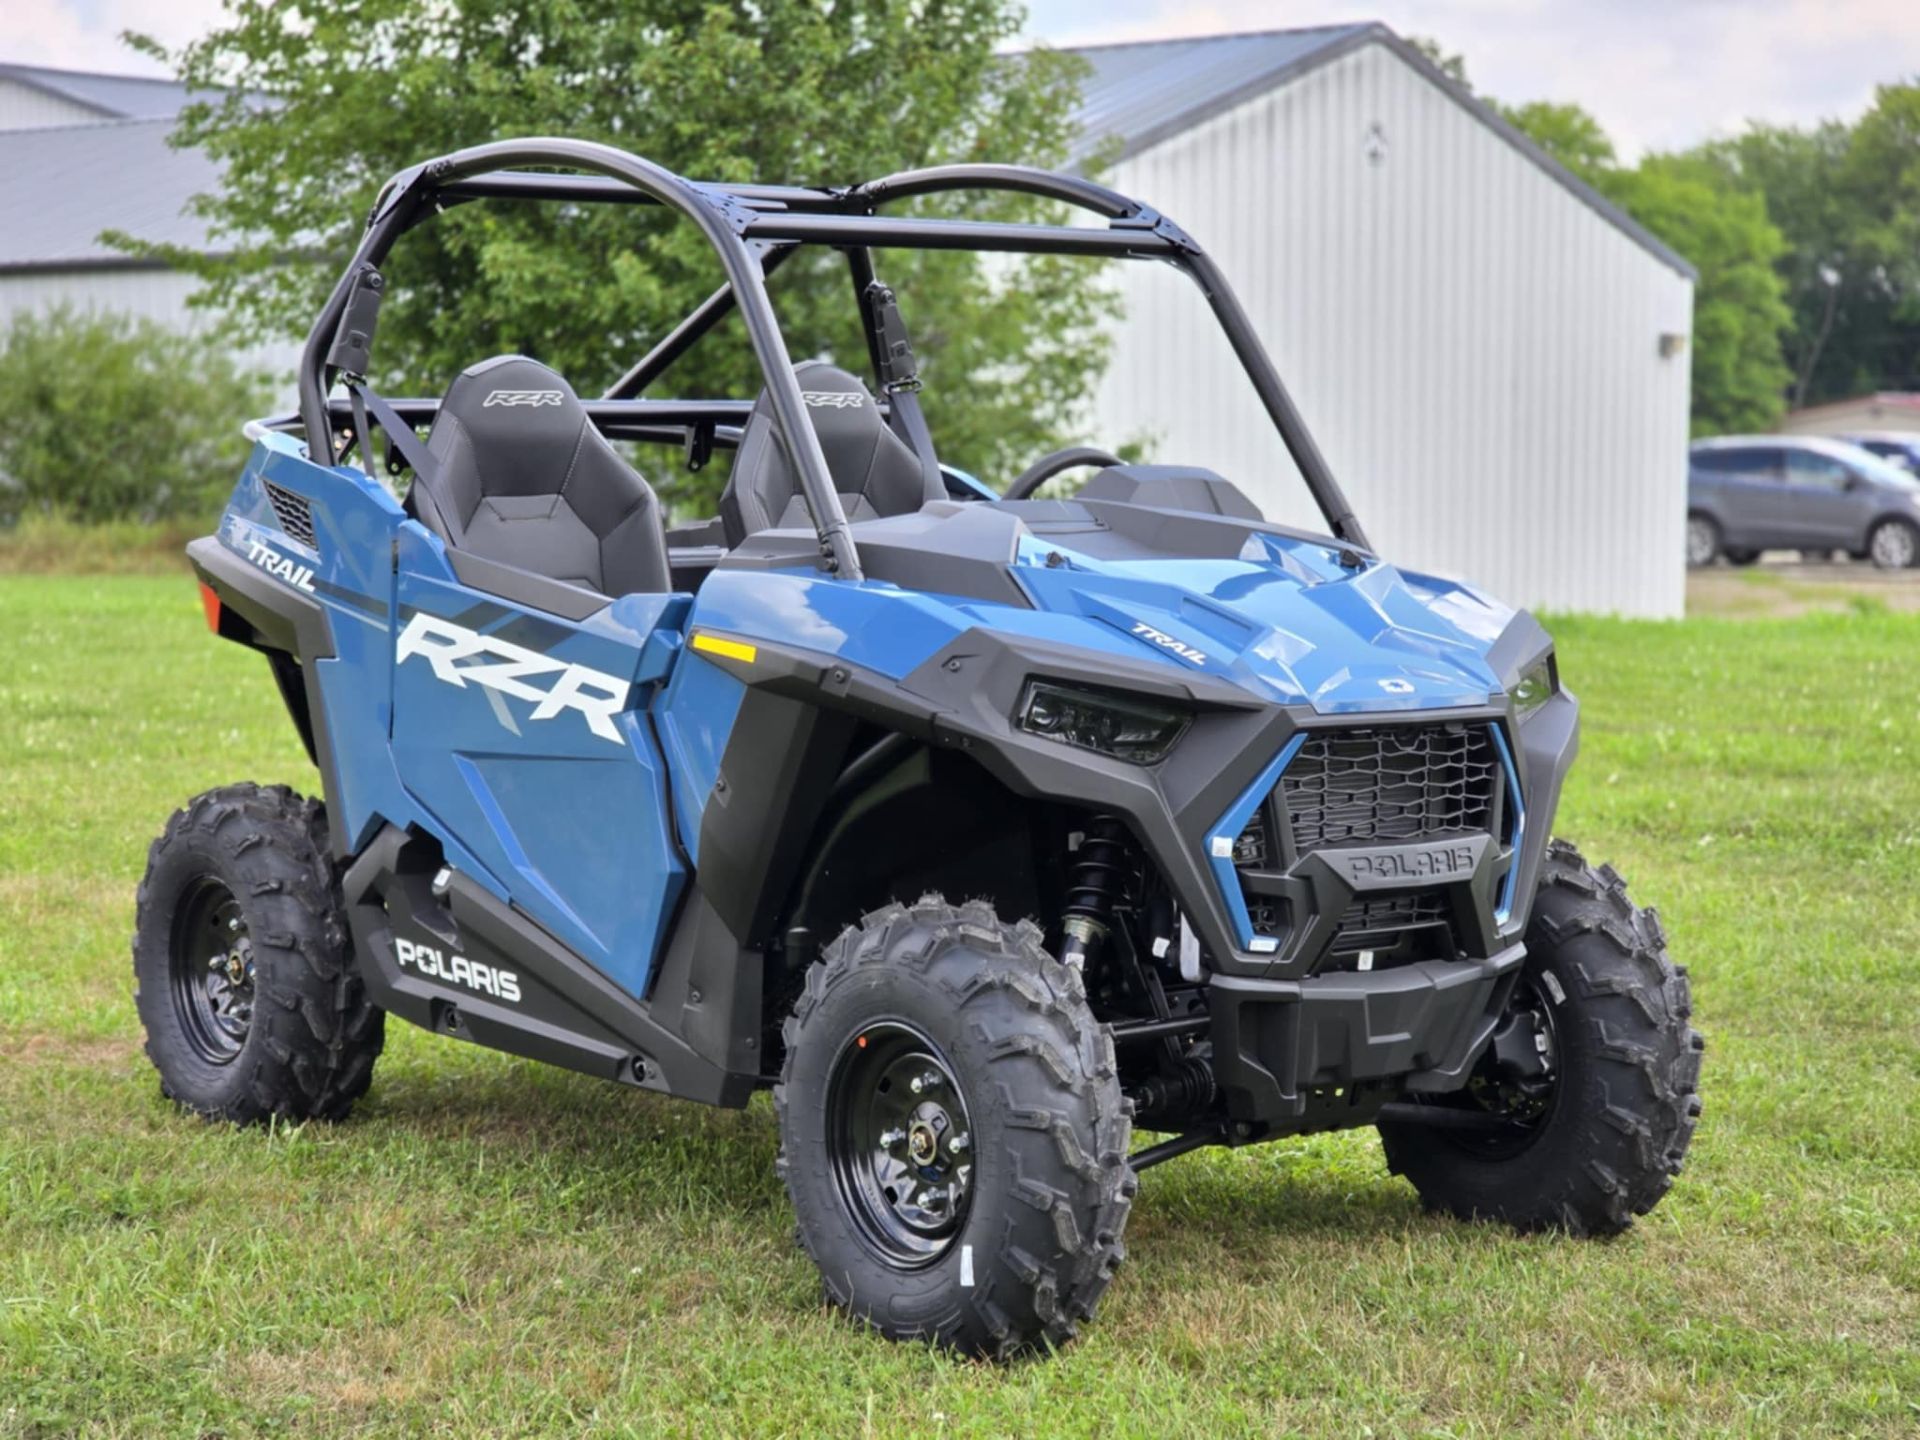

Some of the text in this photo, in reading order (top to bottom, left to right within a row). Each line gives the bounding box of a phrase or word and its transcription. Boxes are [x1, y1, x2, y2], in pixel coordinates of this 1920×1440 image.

[482, 390, 564, 407] RZR
[248, 540, 316, 592] TRAIL
[1132, 622, 1206, 666] TRAIL
[397, 612, 631, 746] RZR
[1348, 846, 1474, 880] POLARIS
[395, 938, 521, 1002] POLARIS
